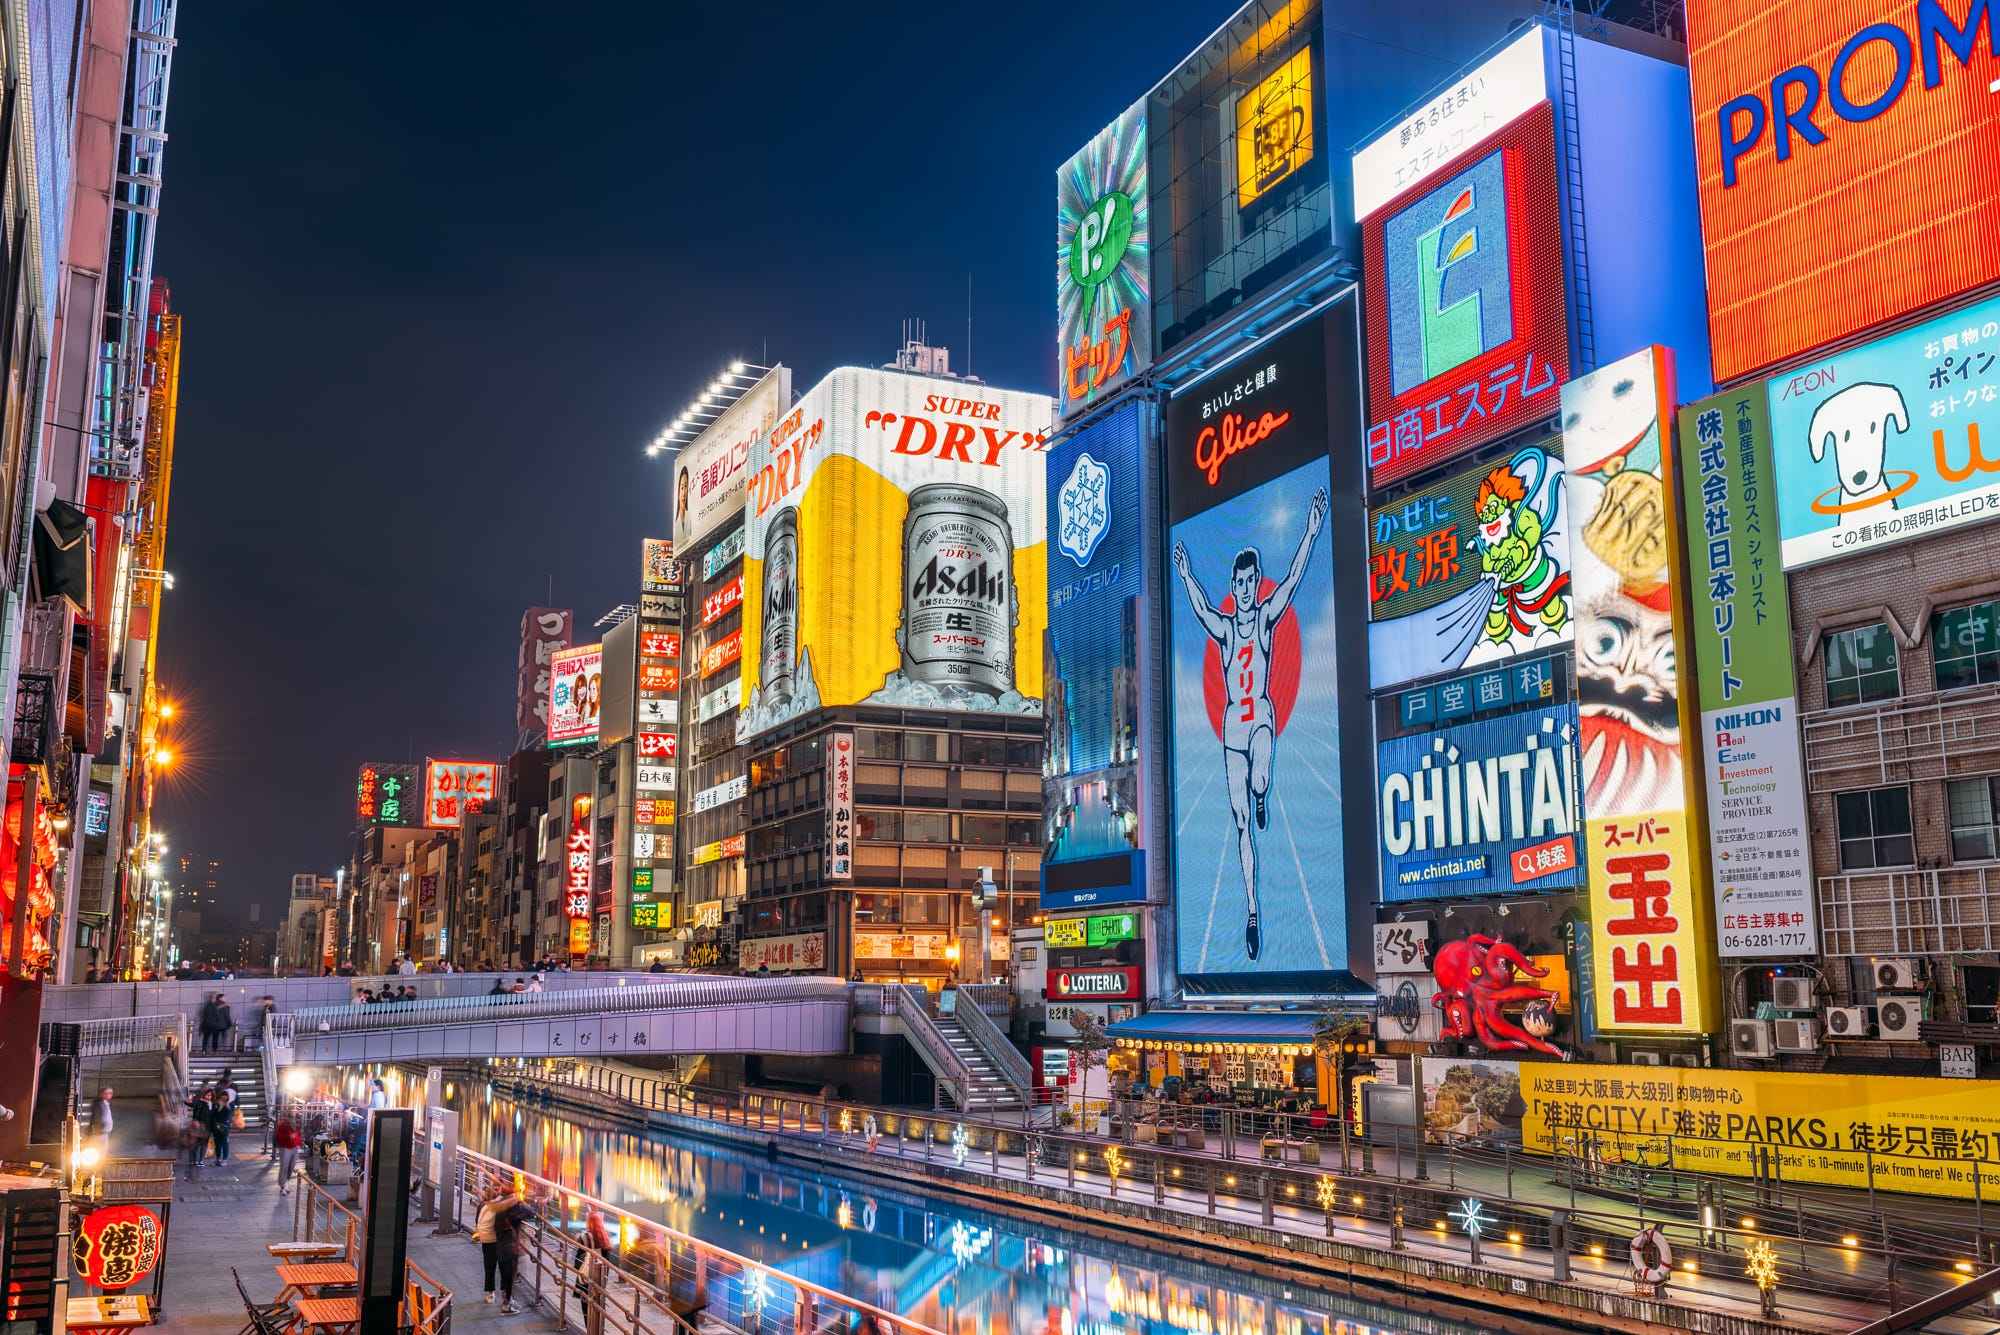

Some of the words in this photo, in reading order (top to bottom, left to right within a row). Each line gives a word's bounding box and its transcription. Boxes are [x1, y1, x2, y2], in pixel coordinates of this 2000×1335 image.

[1400, 77, 1485, 149] 夢ある住まい
[1067, 307, 1131, 399] ピップ
[1924, 321, 1999, 358] お買物の
[1929, 352, 1996, 390] ポイン
[924, 394, 1001, 421] SUPER
[1201, 364, 1278, 419] おいしさと健康
[1930, 385, 1997, 418] おトクな
[1367, 353, 1557, 469] 日商エステム
[1374, 496, 1451, 544] かぜに
[1735, 399, 1768, 626] 不動産再生のスペシャリスト
[1832, 493, 2000, 549] この看板の照明はLEDを
[1368, 525, 1461, 605] 改源
[1697, 408, 1743, 702] 株式会社日本リート
[913, 555, 1004, 606] Asahi
[946, 613, 972, 632] 生
[933, 634, 986, 648] スーパードライ
[1237, 640, 1256, 722] グリコ
[1715, 707, 1782, 731] NIHON
[1716, 732, 1746, 747] Real
[1718, 748, 1757, 764] Estate
[438, 768, 486, 794] かに
[640, 769, 673, 784] 白木屋
[837, 754, 849, 802] 本場の味
[1718, 780, 1777, 796] Technology
[1719, 765, 1774, 781] Investment
[381, 777, 401, 817] 千房
[1721, 795, 1764, 809] SERVICE
[1722, 806, 1773, 820] PROVIDER
[1603, 817, 1670, 849] スーパー
[567, 830, 591, 917] 大阪王将
[1535, 844, 1568, 871] 検索
[1724, 911, 1804, 929] 広告主募集中
[1566, 921, 1575, 956] 2F
[1606, 853, 1683, 1025] 玉出
[1724, 932, 1806, 948] 06-6281-1717
[1071, 974, 1122, 992] LOTTERIA
[552, 1031, 647, 1047] えびす橋
[1941, 1047, 1975, 1062] BAR
[1533, 1078, 1743, 1104] 从这里到大阪最大级别的购物中心
[1726, 1150, 1741, 1161] and
[1808, 1155, 1816, 1167] is
[1818, 1156, 1865, 1173] 10-minute
[1893, 1162, 1916, 1178] from
[1918, 1164, 1944, 1180] here!
[1947, 1167, 1963, 1182] We
[1966, 1171, 2000, 1185] crres
[100, 1223, 138, 1284] 焼鳥
